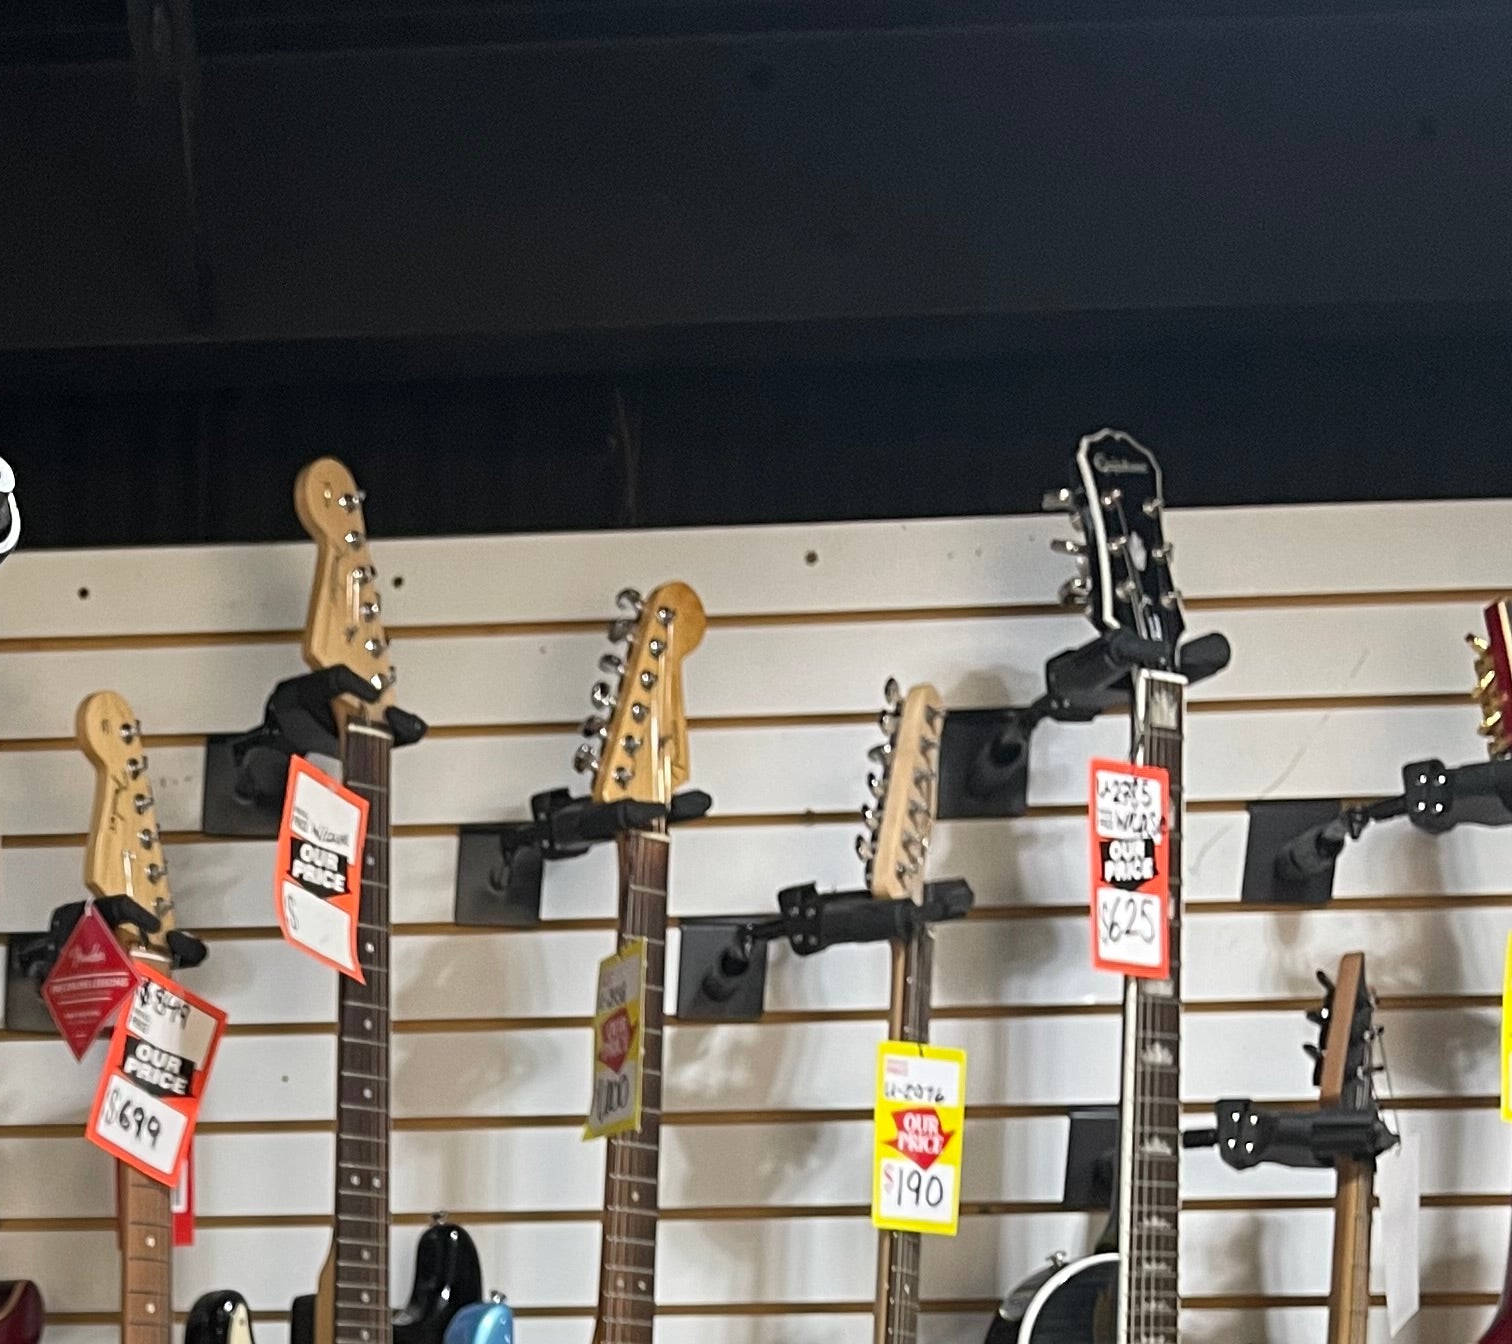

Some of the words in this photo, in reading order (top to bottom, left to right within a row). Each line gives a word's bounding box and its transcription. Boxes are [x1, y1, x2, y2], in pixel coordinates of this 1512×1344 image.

[299, 842, 340, 872] OUR
[1108, 839, 1146, 862] OUR
[291, 858, 347, 893] PRICE
[1103, 857, 1155, 883] PRICE
[134, 1042, 183, 1075] OUR
[123, 1056, 189, 1096] PRICE
[901, 1111, 941, 1135] OUR
[896, 1130, 946, 1156] PRICE
